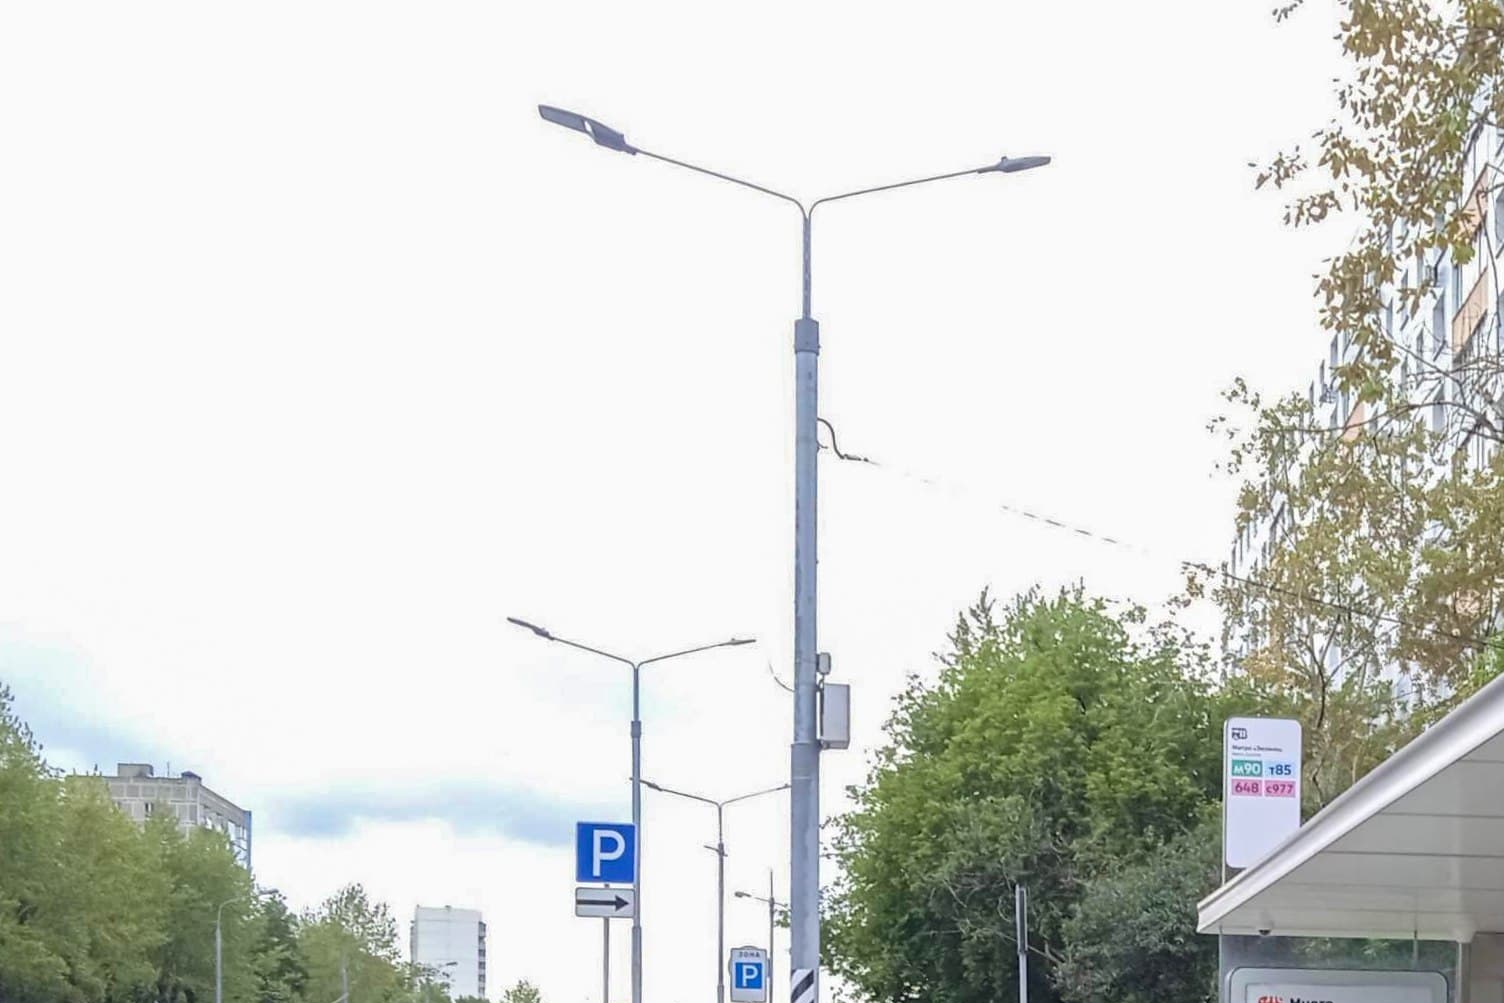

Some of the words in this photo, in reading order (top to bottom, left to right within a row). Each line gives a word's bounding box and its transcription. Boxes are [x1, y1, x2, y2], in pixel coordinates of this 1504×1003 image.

[1235, 782, 1259, 793] 648
[593, 829, 626, 877] P
[743, 965, 758, 986] P
